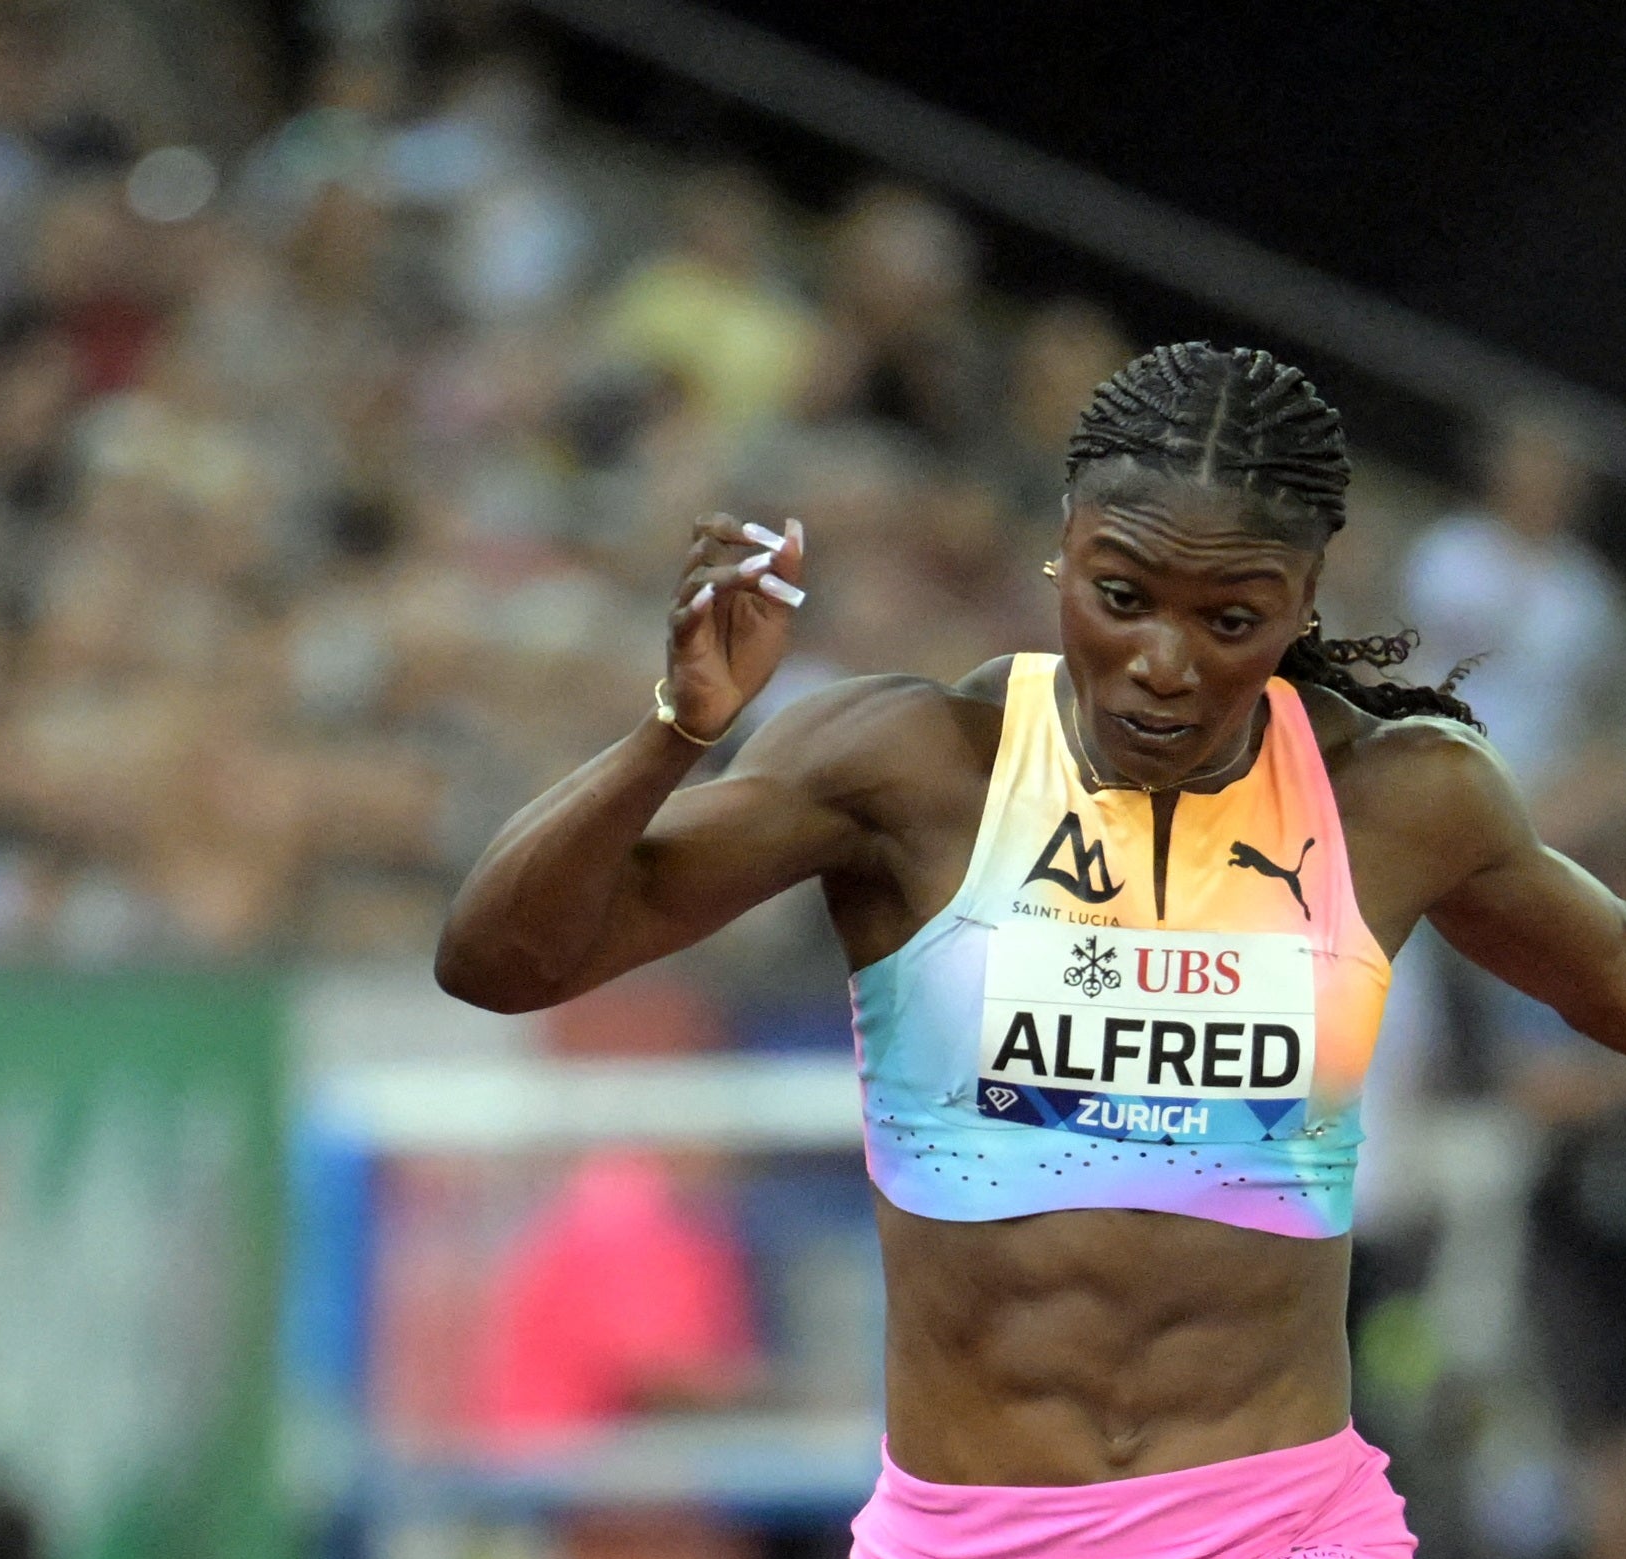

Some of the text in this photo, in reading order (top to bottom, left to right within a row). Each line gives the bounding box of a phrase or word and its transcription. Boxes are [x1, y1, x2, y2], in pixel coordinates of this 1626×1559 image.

[1012, 900, 1122, 928] SAINT LUCIA
[1134, 947, 1241, 995] UBS
[991, 1010, 1301, 1089] ALFRED
[1076, 1098, 1209, 1135] ZURICH
